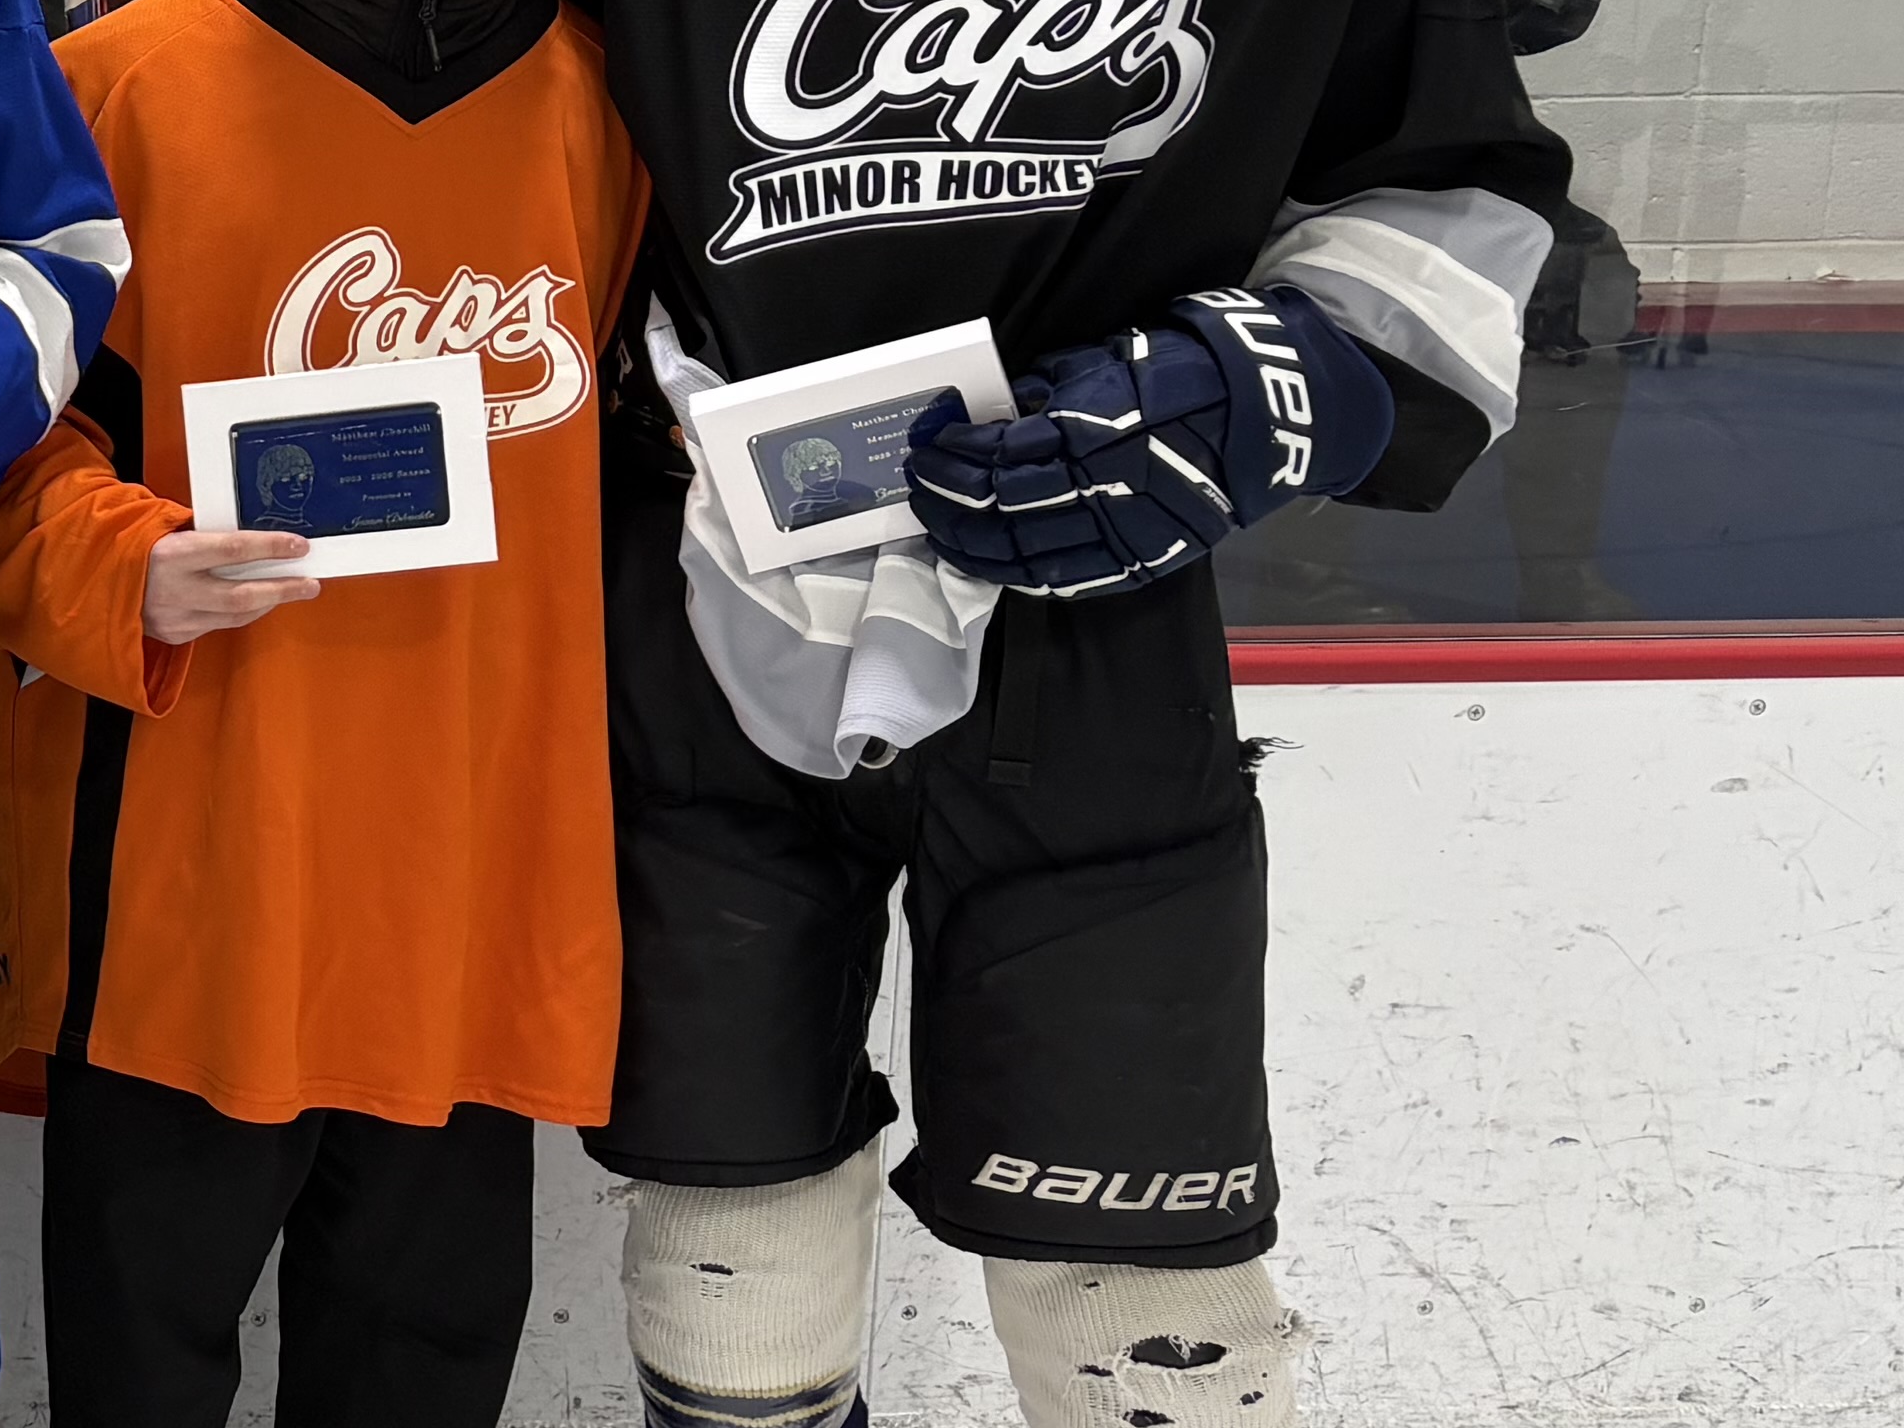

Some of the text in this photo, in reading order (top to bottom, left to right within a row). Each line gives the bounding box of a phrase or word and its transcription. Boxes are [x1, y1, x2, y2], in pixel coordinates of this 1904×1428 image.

[757, 160, 920, 229] MINOR
[264, 226, 590, 377] Caps
[1185, 287, 1312, 489] AUER
[971, 1153, 1258, 1211] BAUER
